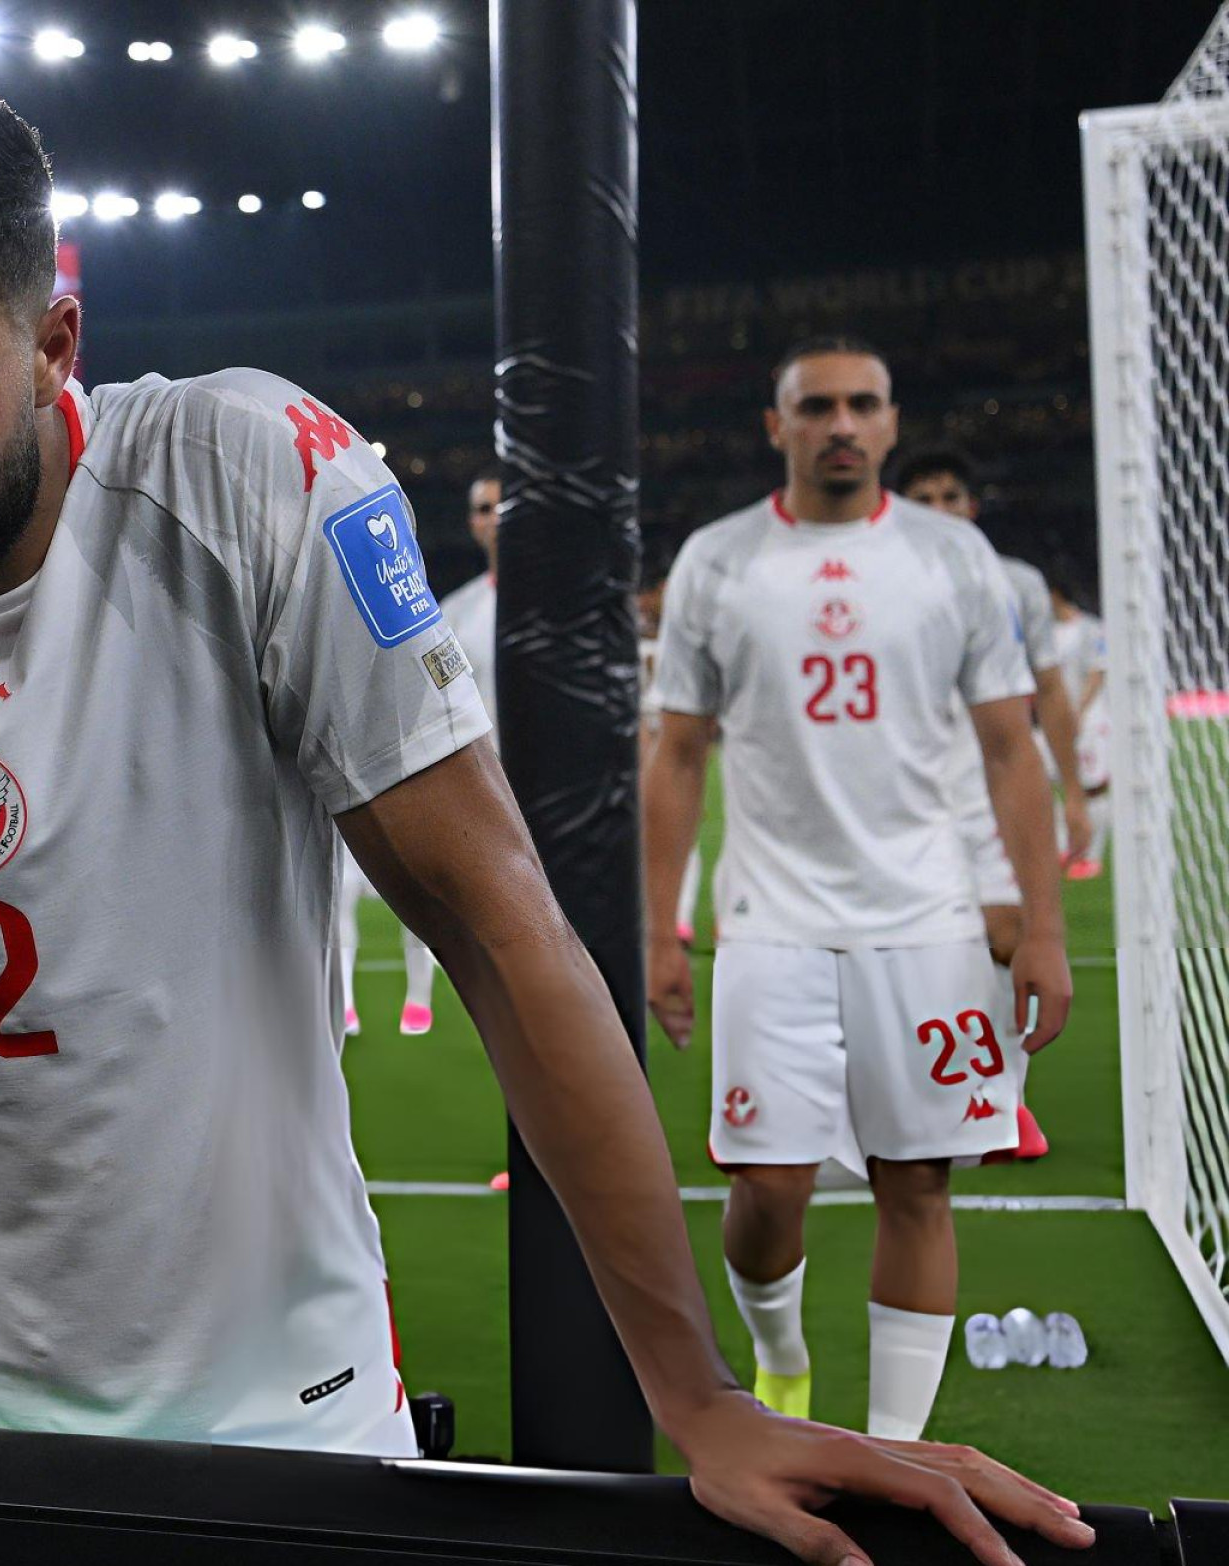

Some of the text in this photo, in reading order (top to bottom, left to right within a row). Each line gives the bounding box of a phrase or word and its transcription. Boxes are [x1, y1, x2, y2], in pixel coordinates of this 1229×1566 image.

[411, 598, 430, 616] FIFA
[802, 654, 877, 724] 23
[917, 1009, 1004, 1086] 23
